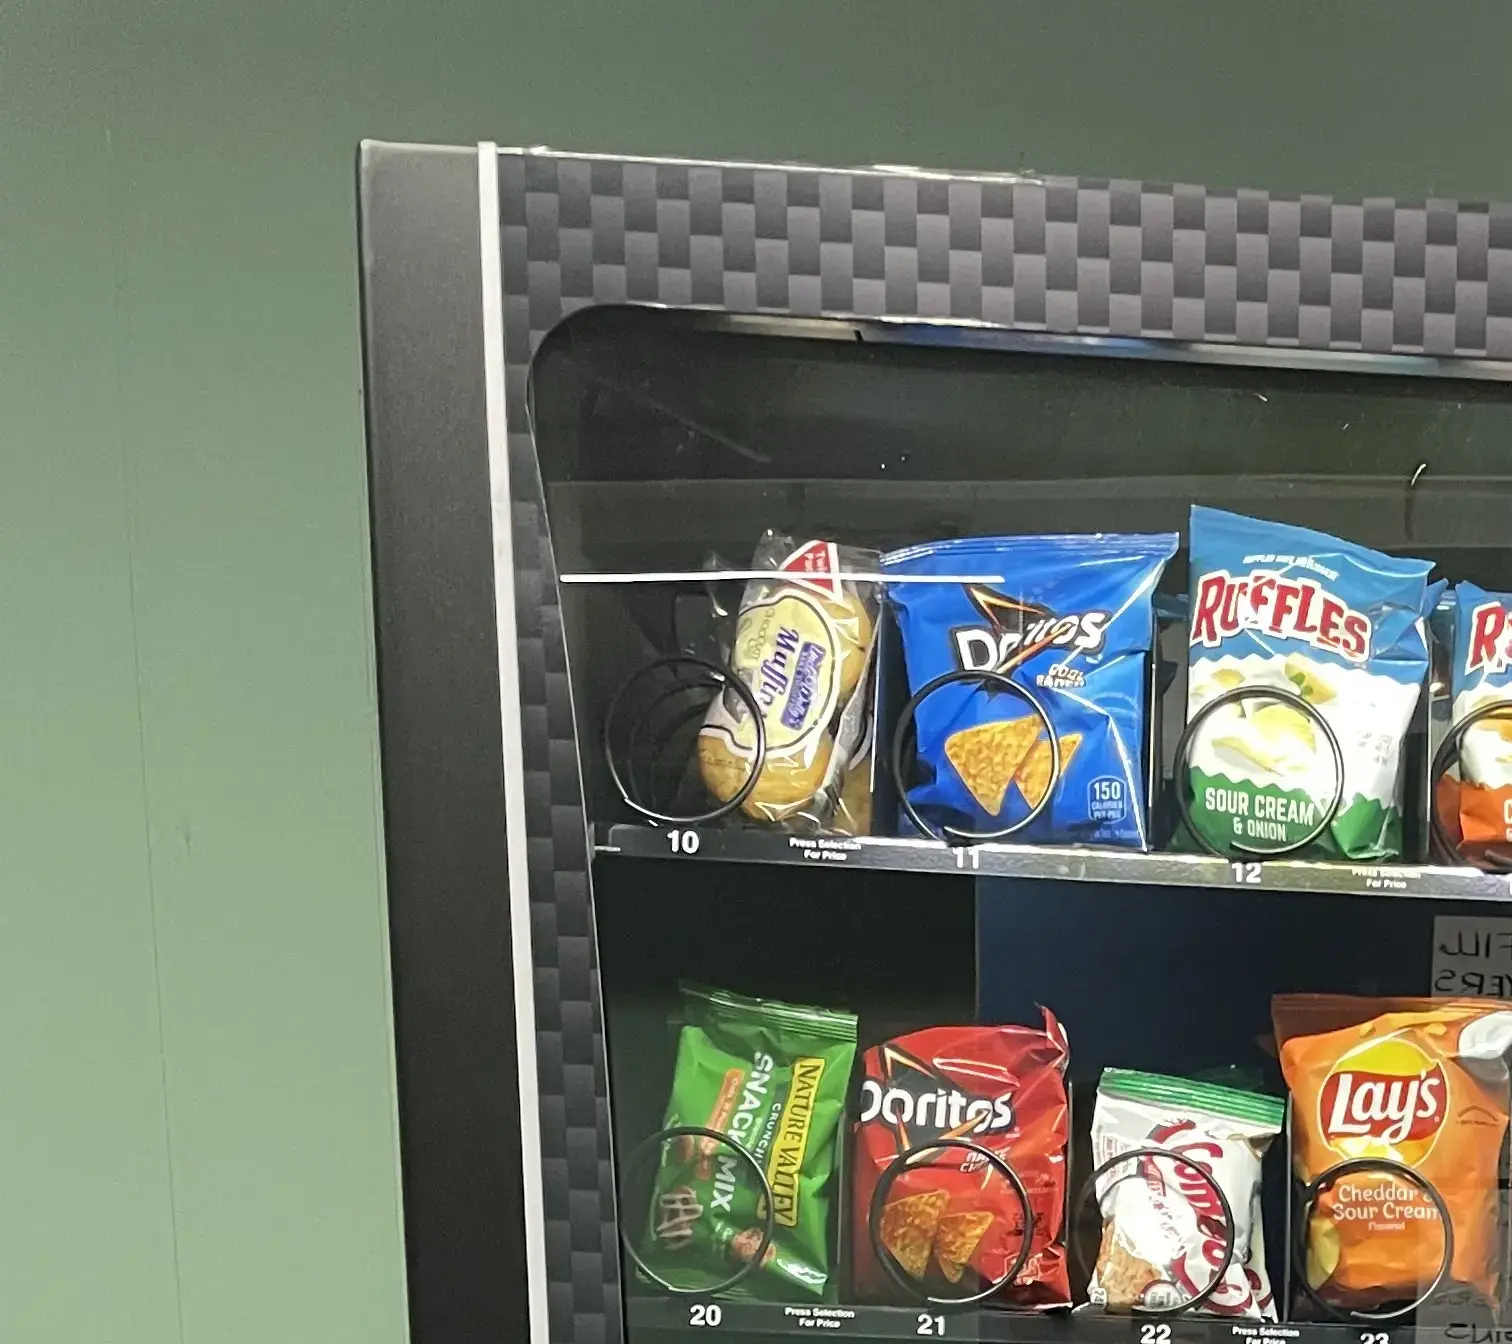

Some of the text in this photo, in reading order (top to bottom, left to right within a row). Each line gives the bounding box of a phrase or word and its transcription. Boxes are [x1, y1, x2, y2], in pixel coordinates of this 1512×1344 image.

[1093, 781, 1121, 801] 150
[1205, 787, 1315, 827] SOUR CREAM
[1232, 816, 1288, 842] & ONION
[667, 830, 700, 854] 10
[952, 846, 981, 869] 11
[1231, 861, 1263, 884] 12
[726, 1051, 775, 1149] SNACK
[1328, 1070, 1441, 1144] Lay's
[772, 1063, 822, 1222] NATURE VALLEY
[710, 1155, 737, 1213] MIX
[1338, 1180, 1419, 1203] Cheddar
[1331, 1201, 1443, 1221] Sour Cream
[690, 1305, 722, 1327] 20
[784, 1307, 856, 1319] Press Selection
[799, 1318, 841, 1329] For Price
[917, 1314, 946, 1335] 21
